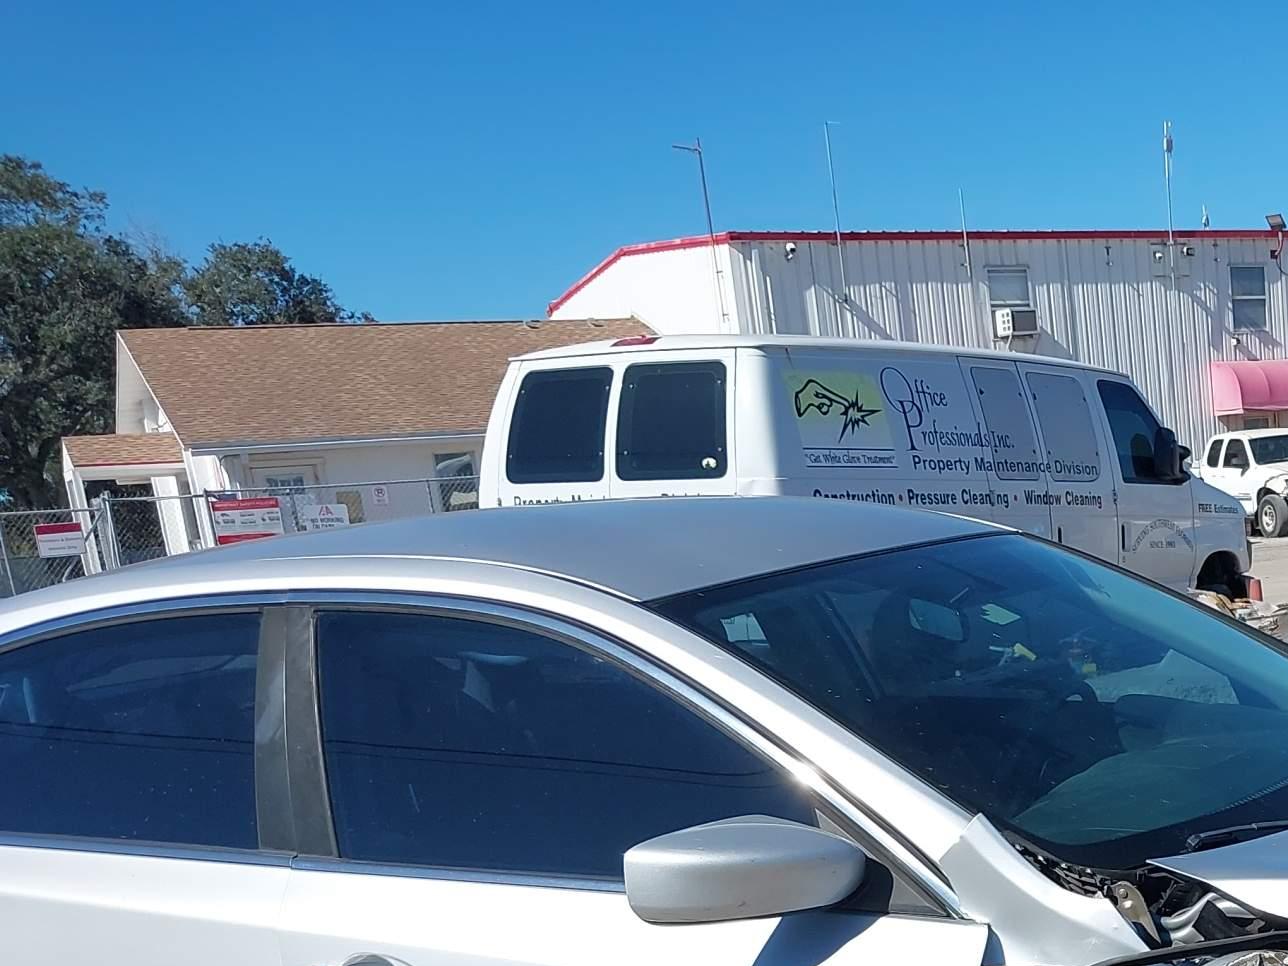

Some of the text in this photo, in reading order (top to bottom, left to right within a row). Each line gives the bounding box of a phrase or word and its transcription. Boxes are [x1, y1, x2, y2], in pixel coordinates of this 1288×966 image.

[880, 366, 948, 413] Office
[898, 399, 1015, 452] Professionals Inc.
[912, 454, 1099, 476] Property Maintenance Division
[907, 488, 957, 505] Pressure
[961, 488, 1010, 508] Cleaning
[1023, 489, 1061, 506] Window
[1065, 490, 1103, 509] Cleaning
[1198, 504, 1212, 513] FREE
